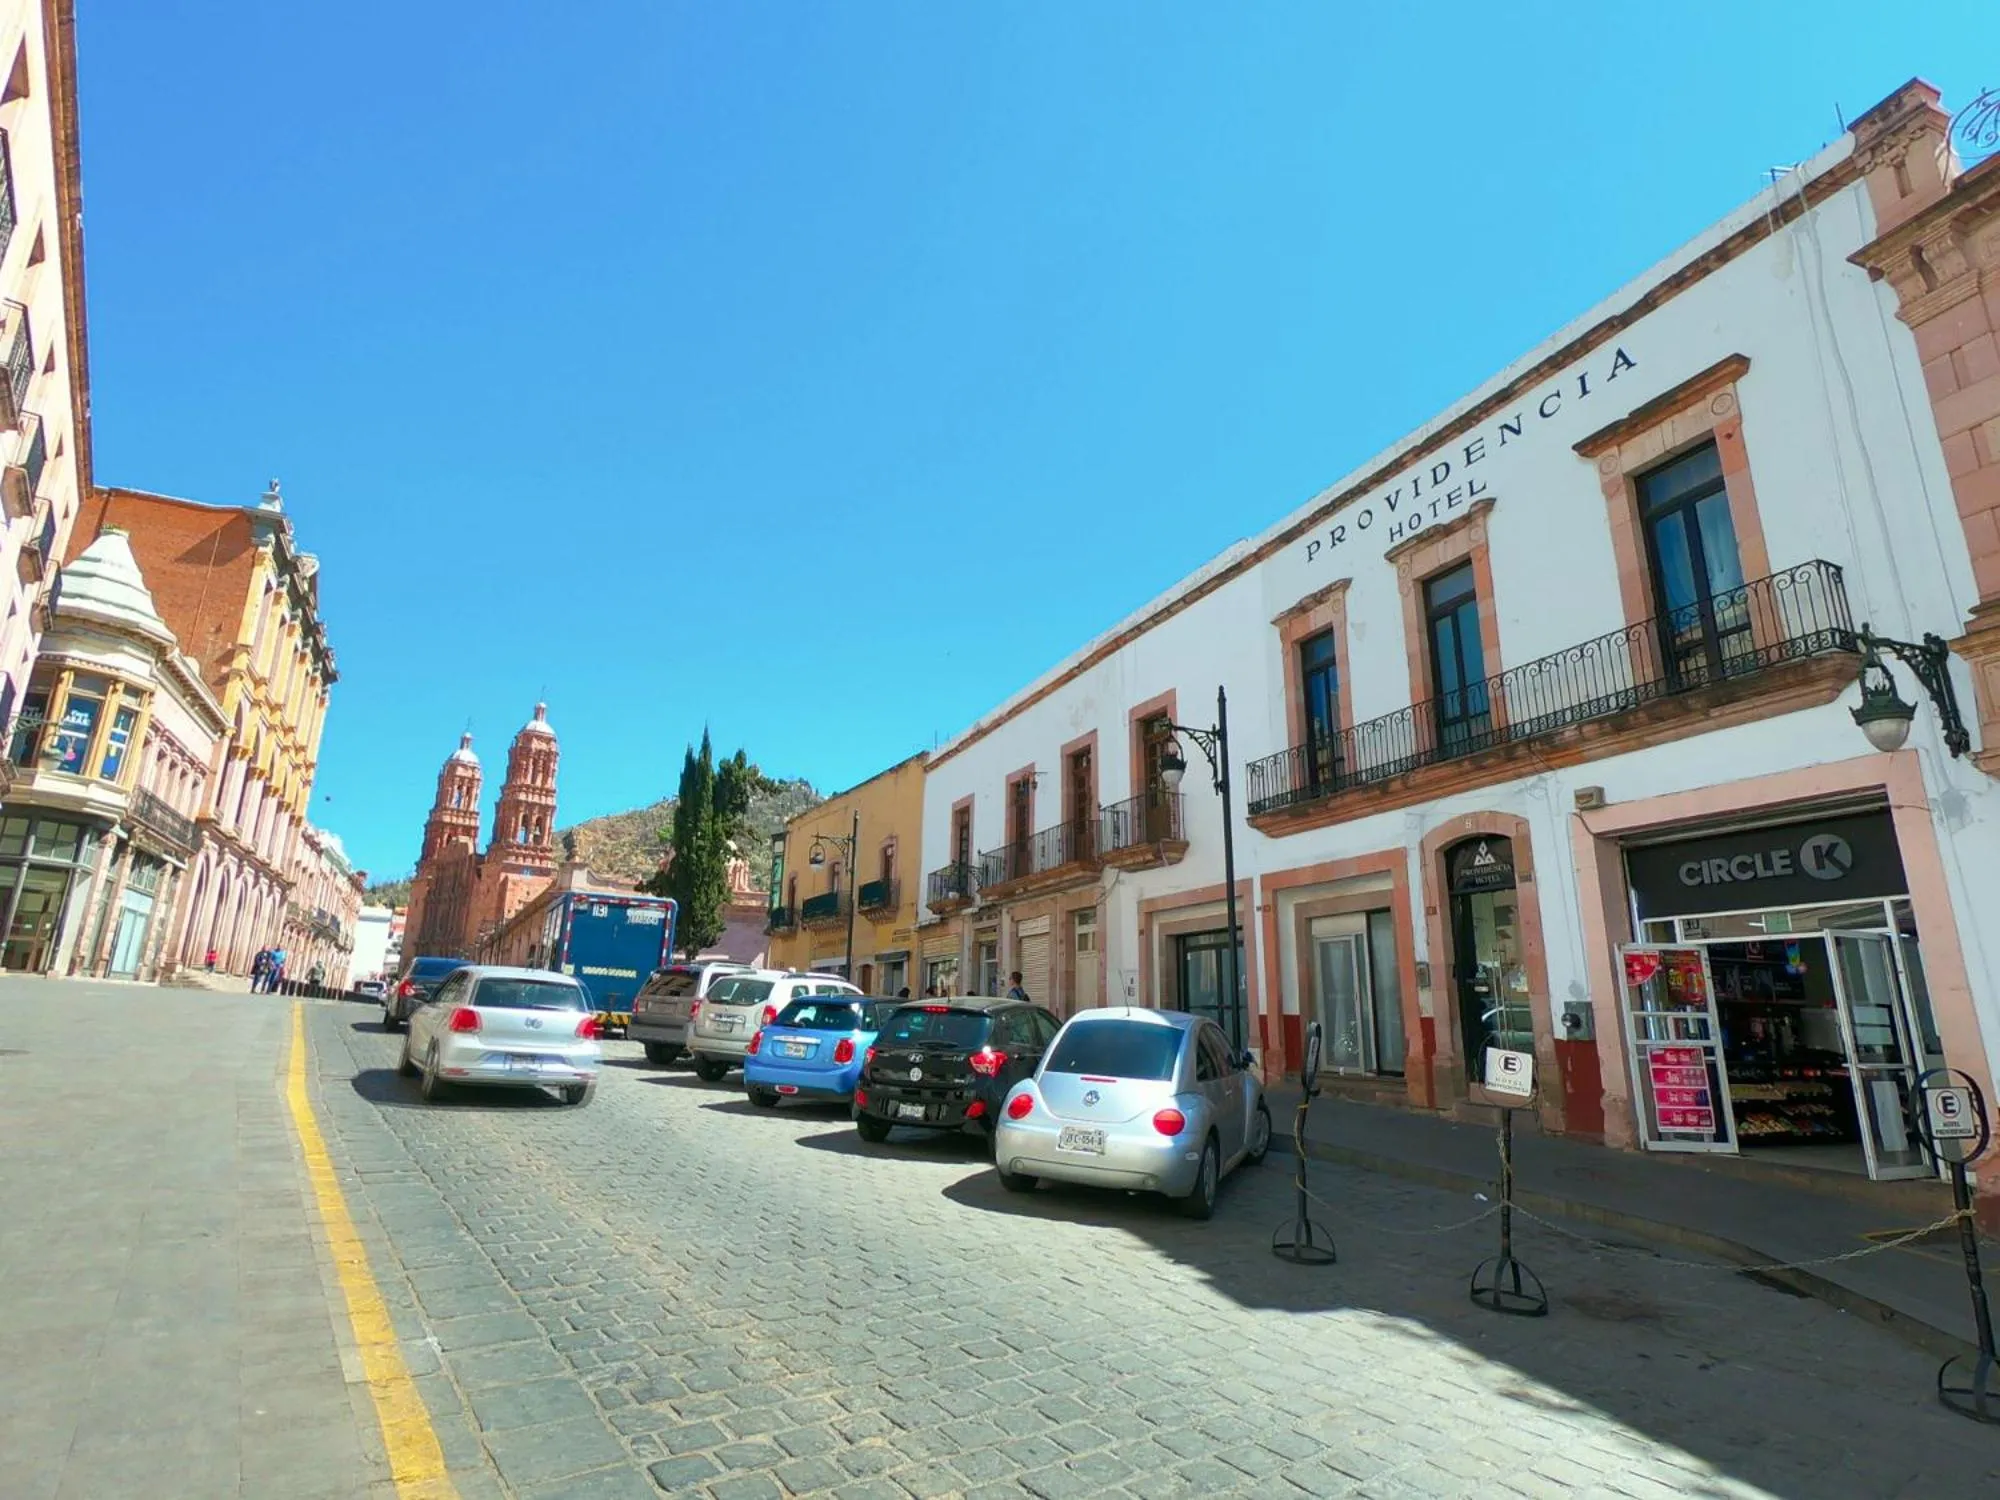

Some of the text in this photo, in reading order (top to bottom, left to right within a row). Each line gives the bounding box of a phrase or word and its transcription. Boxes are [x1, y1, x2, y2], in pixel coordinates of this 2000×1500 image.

[1306, 347, 1637, 563] PROVIDENCIA
[1389, 478, 1487, 543] HOTEL
[1679, 841, 1851, 886] CIRCLE K
[1503, 1056, 1517, 1072] E
[1941, 1095, 1957, 1114] E
